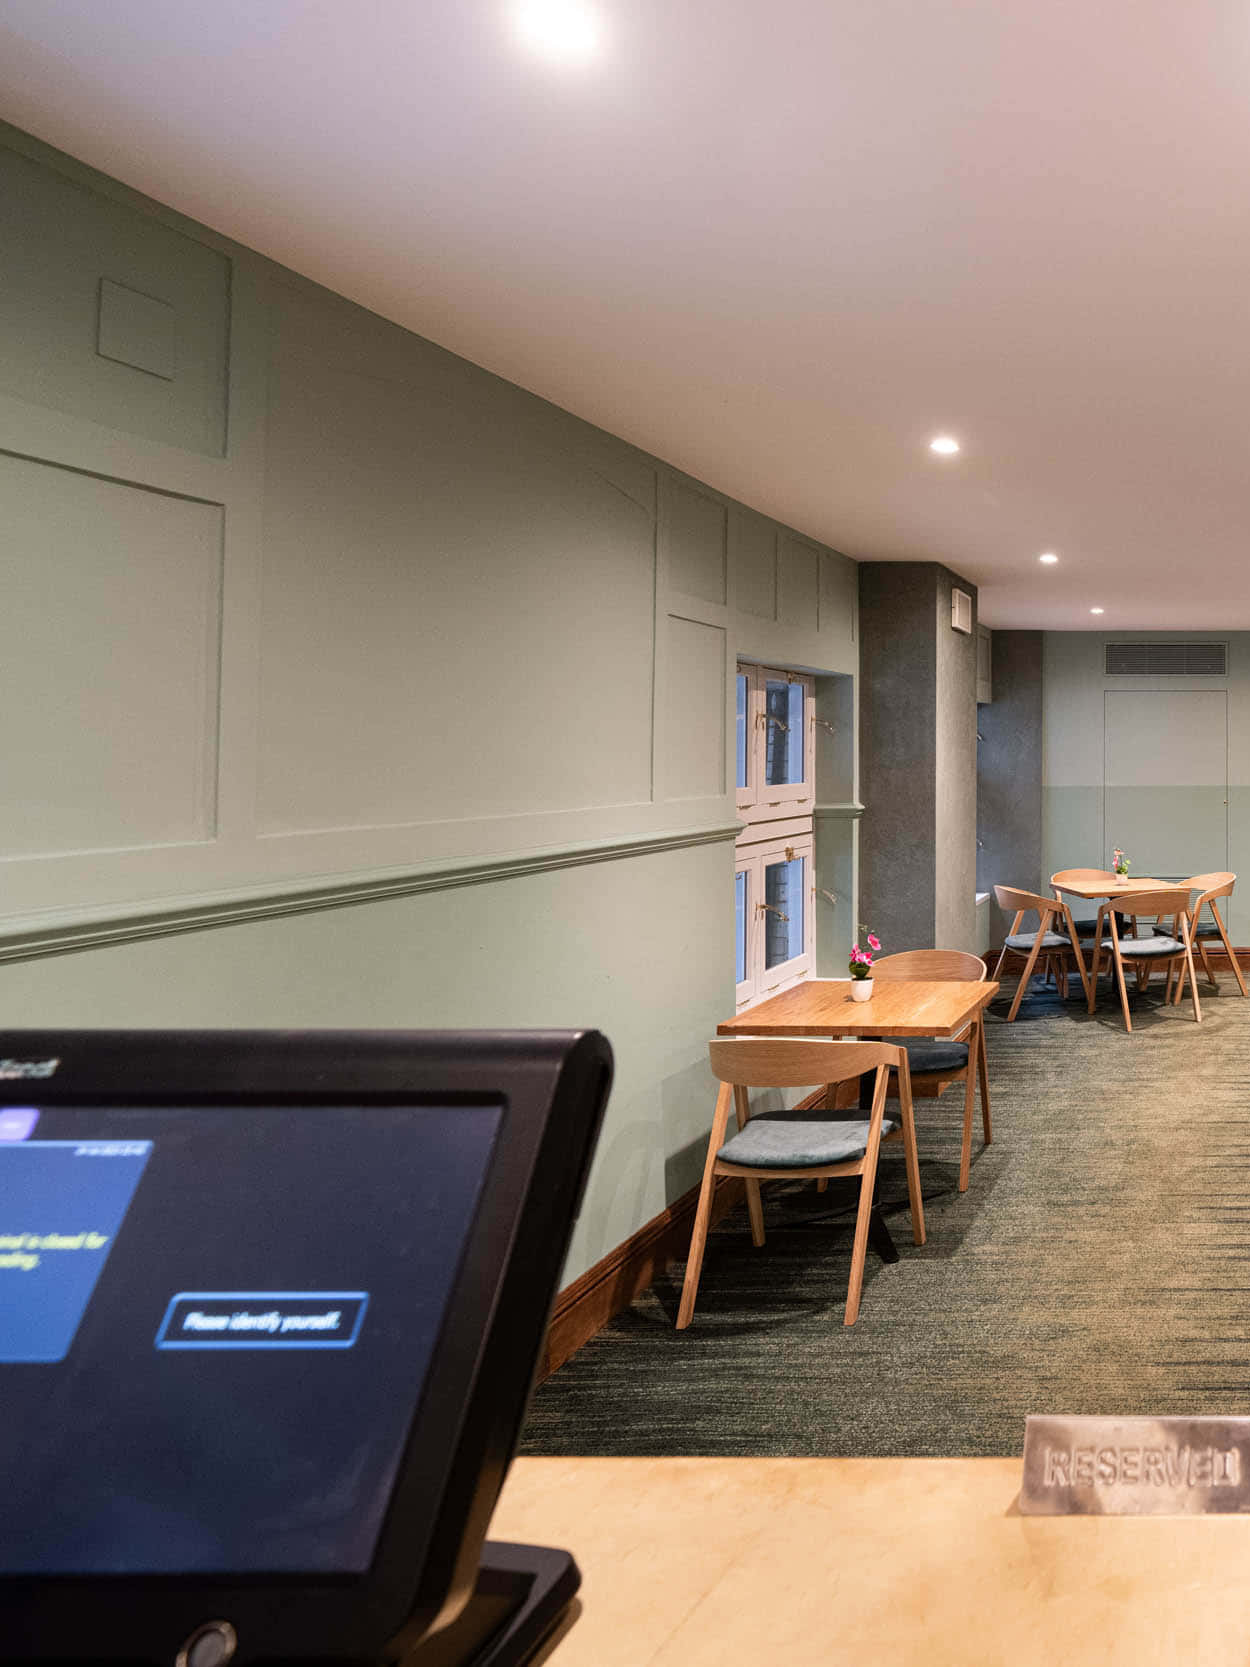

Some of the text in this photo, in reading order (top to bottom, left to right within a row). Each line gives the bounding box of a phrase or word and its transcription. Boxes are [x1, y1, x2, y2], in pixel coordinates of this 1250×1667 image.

[182, 1311, 230, 1331] Please
[228, 1311, 281, 1334] identify
[1043, 1444, 1241, 1488] RESERVED
